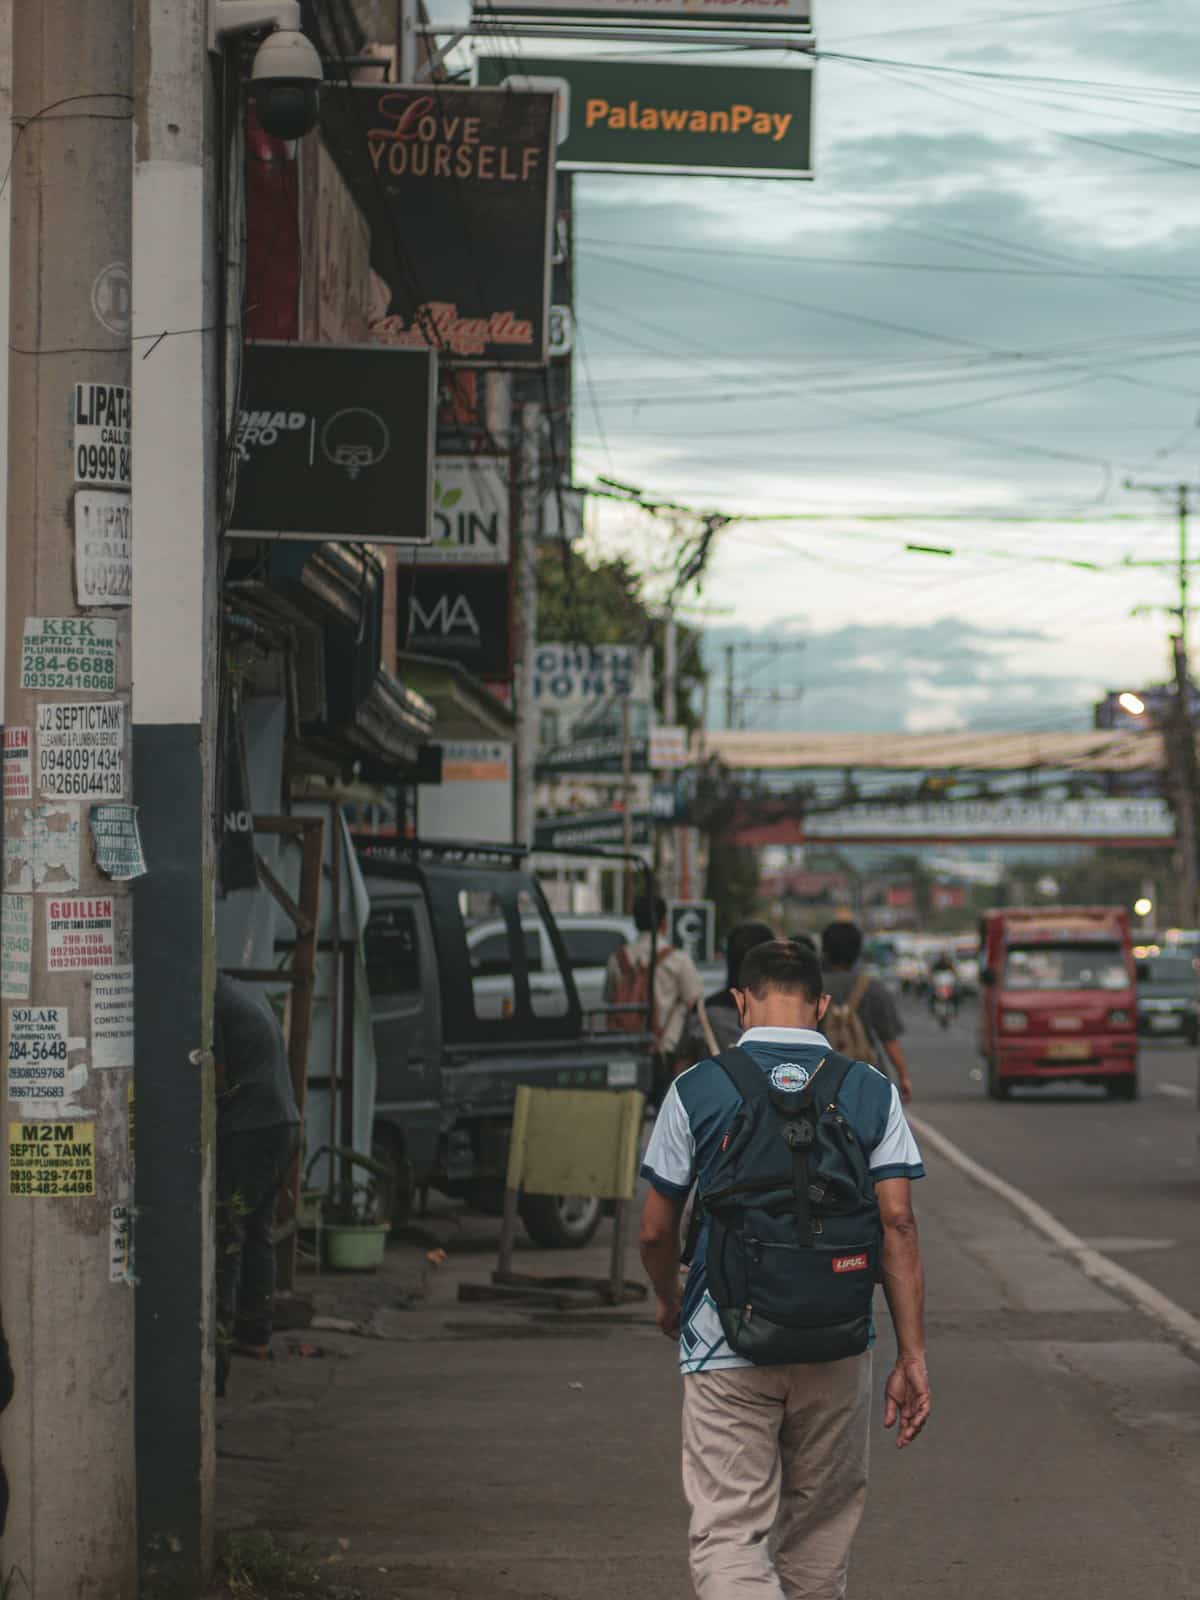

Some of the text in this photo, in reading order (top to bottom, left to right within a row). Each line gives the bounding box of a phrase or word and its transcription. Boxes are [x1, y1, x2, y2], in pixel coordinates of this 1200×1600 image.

[585, 99, 792, 142] PalawanPay
[367, 141, 542, 180] YOURSELF
[78, 445, 116, 479] 0999
[42, 619, 95, 636] KRK
[24, 636, 113, 648] SEPTIC TANK
[24, 647, 84, 655] PLUMBING
[24, 656, 114, 673] 284-6688
[24, 674, 114, 690] 09352416068
[40, 707, 52, 730] J2
[40, 750, 122, 771] 09480914341
[50, 901, 112, 919] GUILLEN
[50, 920, 69, 930] SEPTIC
[12, 1009, 58, 1023] SOLAR
[11, 1033, 45, 1041] PLUMBING
[9, 1041, 67, 1060] 284-5648
[22, 1125, 74, 1141] M2M
[10, 1143, 92, 1157] SEPTIC TANK
